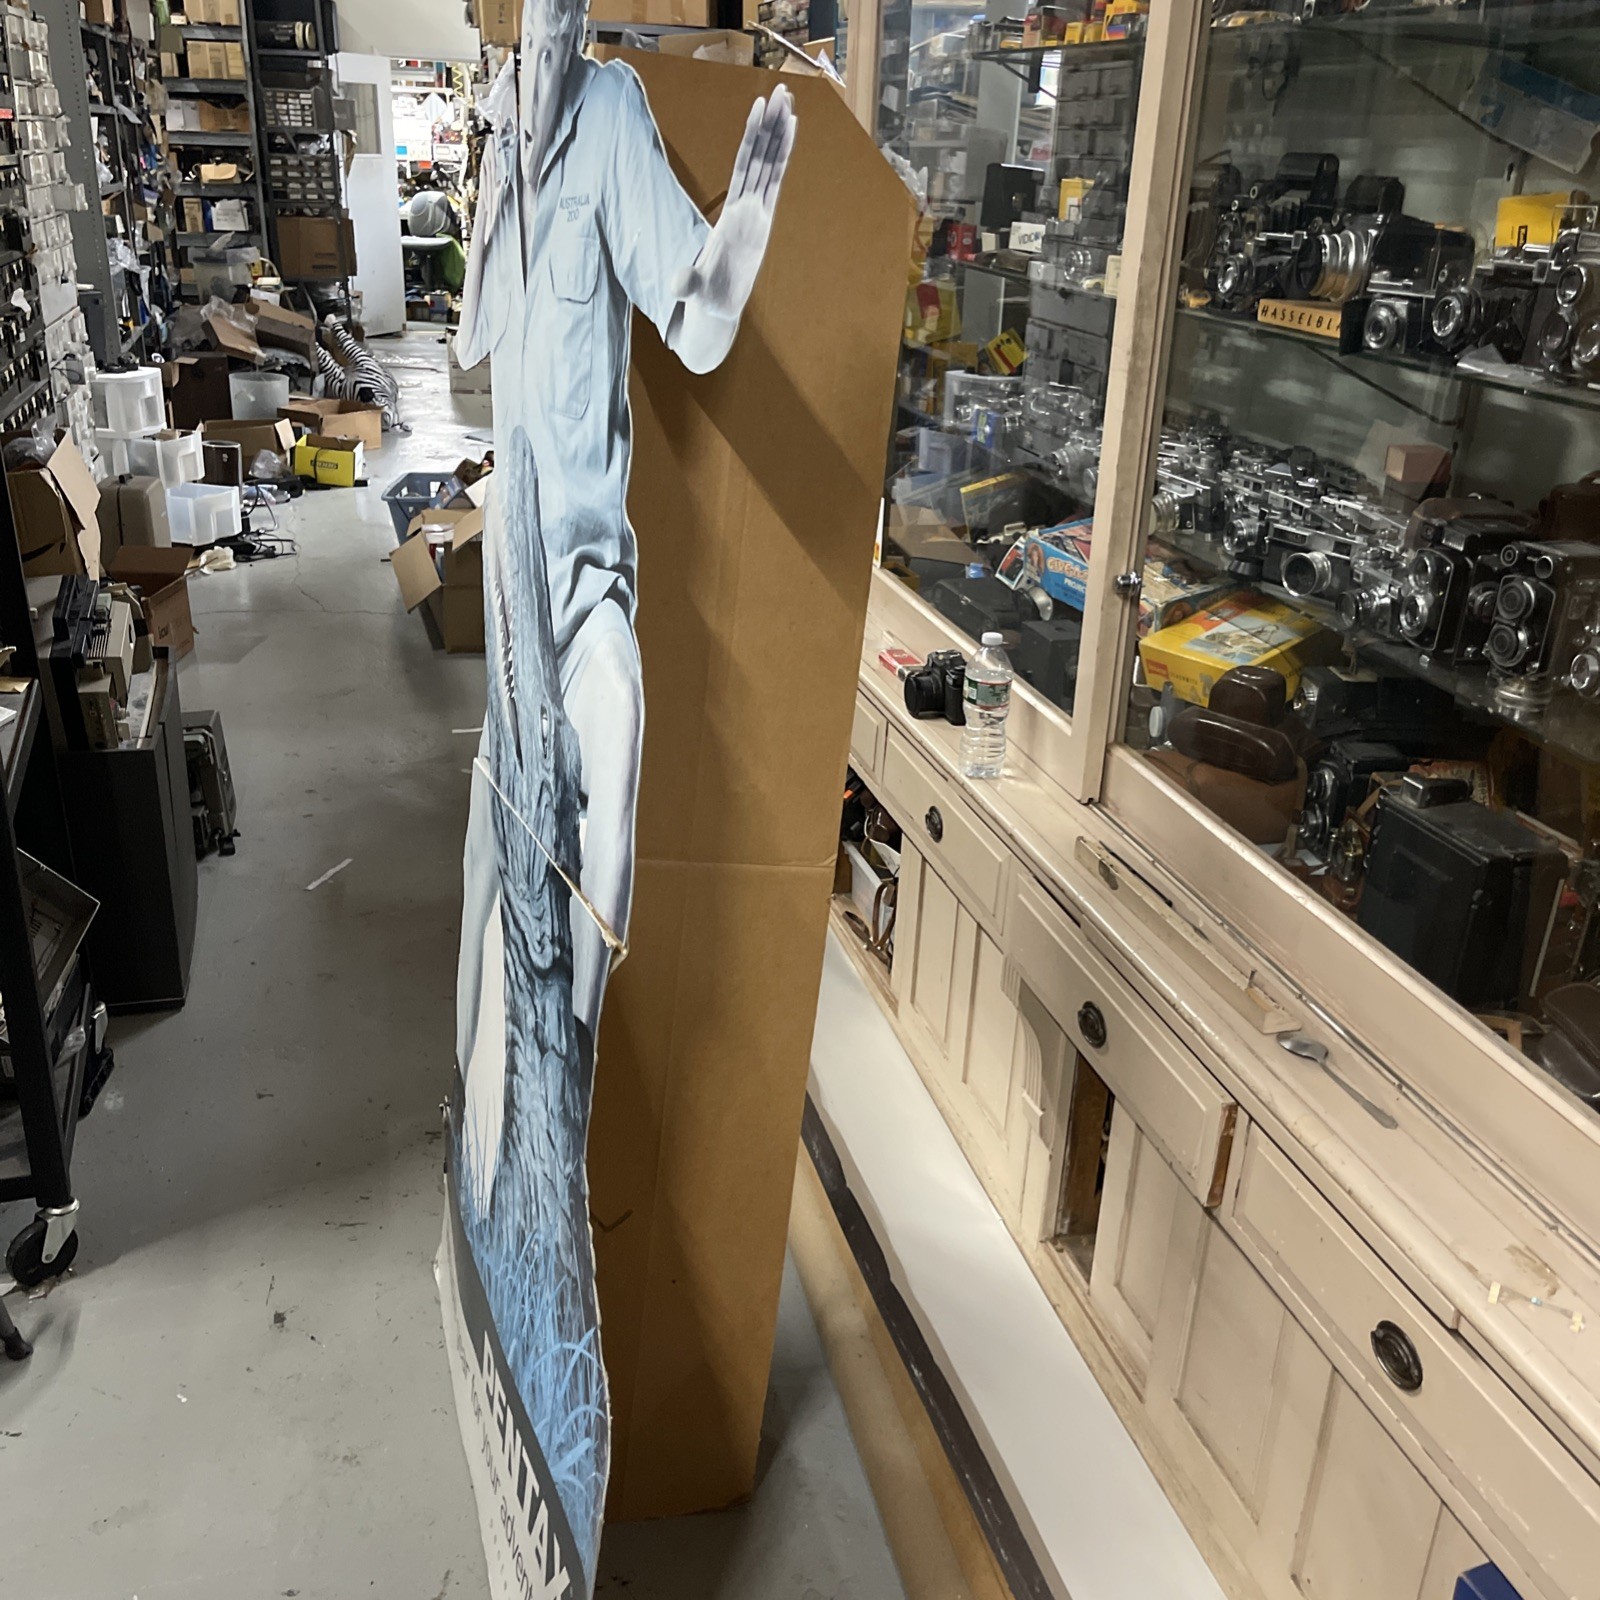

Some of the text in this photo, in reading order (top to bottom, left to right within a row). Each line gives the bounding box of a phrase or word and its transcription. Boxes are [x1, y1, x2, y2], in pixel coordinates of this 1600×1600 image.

[560, 193, 590, 210] AUSTRALIA
[567, 208, 580, 222] ZOO
[481, 1329, 571, 1600] PENTAX
